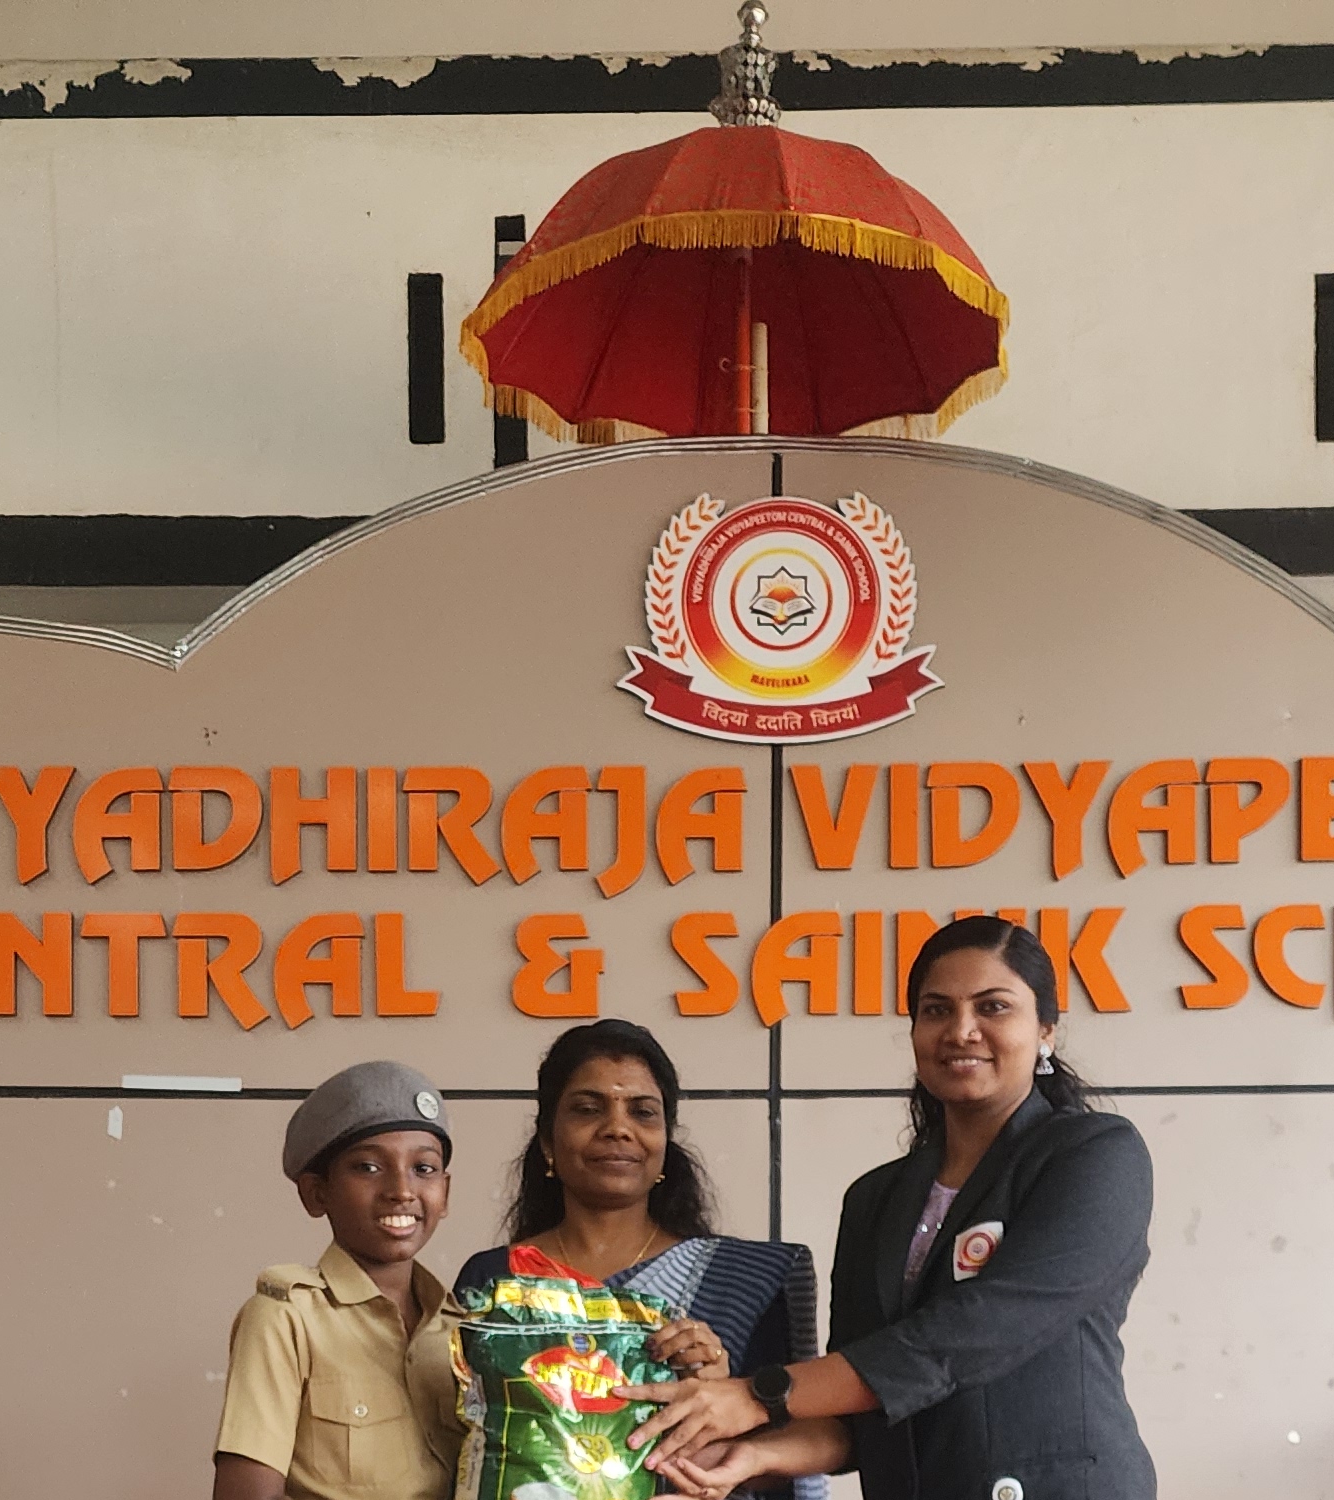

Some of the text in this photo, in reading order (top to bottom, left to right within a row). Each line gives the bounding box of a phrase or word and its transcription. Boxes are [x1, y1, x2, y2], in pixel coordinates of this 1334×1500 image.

[787, 513, 827, 532] CENTRAL
[512, 912, 603, 1018] &
[670, 907, 1131, 1027] SAIK
